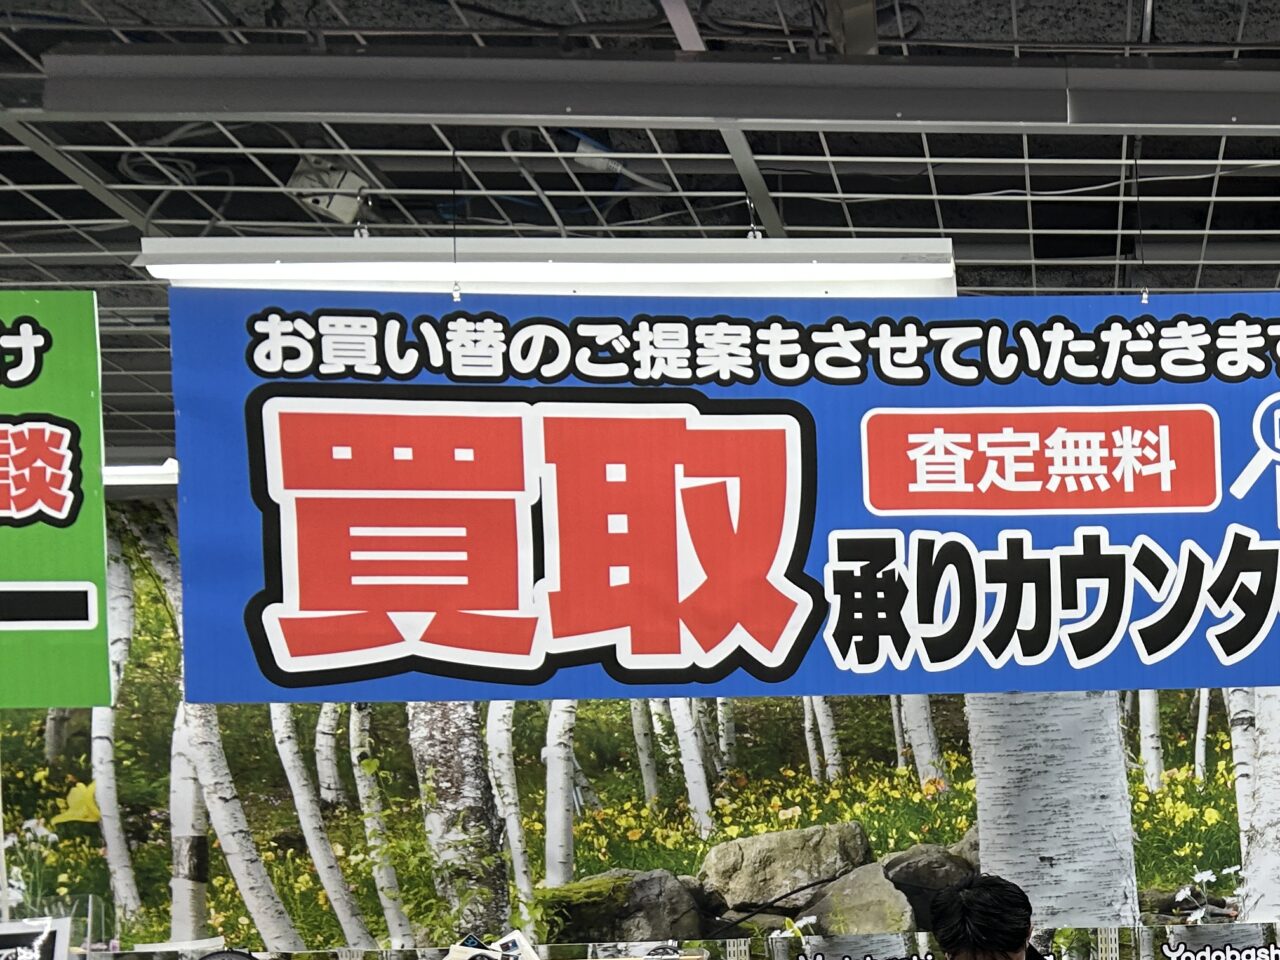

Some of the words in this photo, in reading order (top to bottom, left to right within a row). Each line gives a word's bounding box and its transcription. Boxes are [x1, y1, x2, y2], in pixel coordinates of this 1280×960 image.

[262, 396, 813, 670] 買取
[907, 424, 1176, 493] 査定無料
